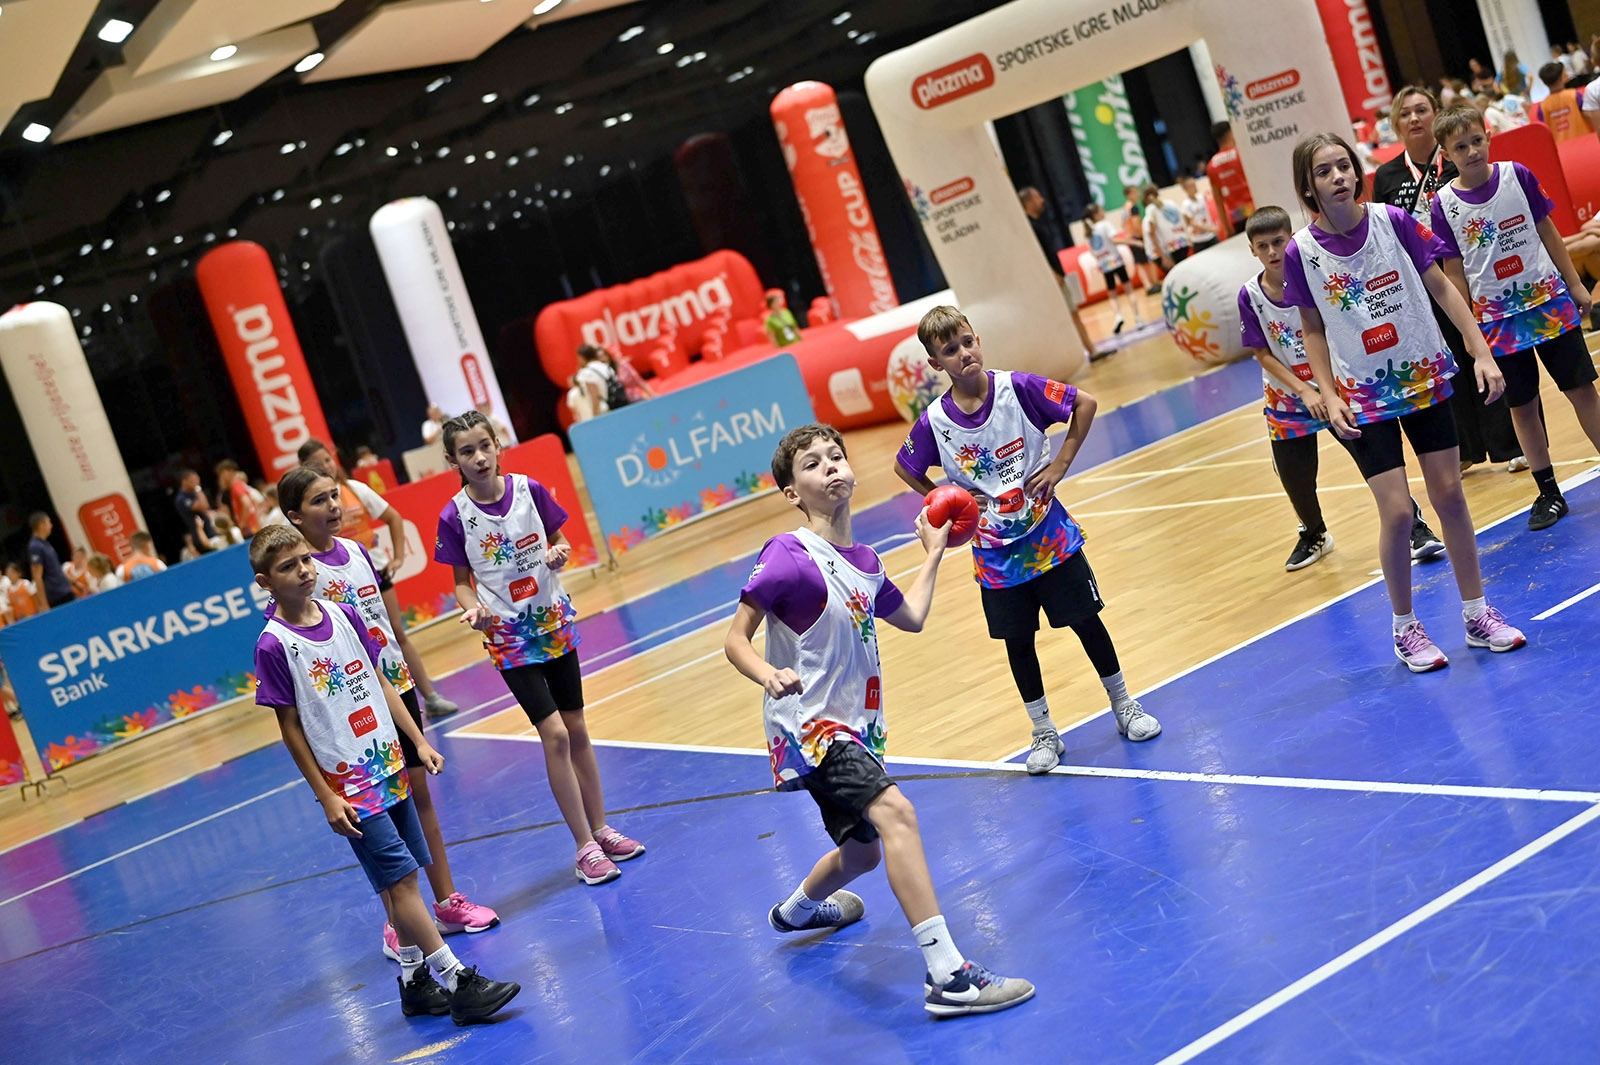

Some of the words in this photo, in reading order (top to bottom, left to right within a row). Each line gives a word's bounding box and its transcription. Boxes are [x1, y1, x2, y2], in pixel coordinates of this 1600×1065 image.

[916, 62, 986, 107] plazma
[996, 28, 1074, 72] SPORTSKE
[1073, 12, 1112, 42] IGRE
[1112, 0, 1168, 25] MLAD
[1346, 0, 1394, 112] lazm
[1243, 90, 1306, 120] SPORTSKE
[1246, 117, 1273, 133] IGRE
[1250, 123, 1299, 147] MLADIH
[837, 170, 871, 229] CUP
[1497, 223, 1529, 242] SPORTSKE
[1500, 216, 1523, 230] plazma
[1498, 236, 1516, 248] IGRE
[1501, 238, 1528, 254] MLADIH
[1368, 273, 1397, 291] plazma
[1364, 282, 1404, 305] SPORTSKE
[580, 275, 733, 352] plazma
[1367, 299, 1387, 313] IGRE
[1370, 302, 1403, 321] MLADIH
[1366, 328, 1395, 347] m:tel
[232, 303, 312, 470] lazma
[615, 401, 787, 488] DOLFARM
[997, 440, 1024, 459] plazma
[995, 452, 1025, 472] SPORTS
[998, 465, 1016, 480] IGRE
[514, 542, 543, 560] SPORTSKE
[518, 560, 543, 574] MLADIH
[512, 581, 535, 596] m:tel
[37, 586, 252, 686] SPARKASSE
[49, 672, 110, 709] Bank
[349, 683, 365, 696] IGRE
[353, 712, 375, 731] m:tel
